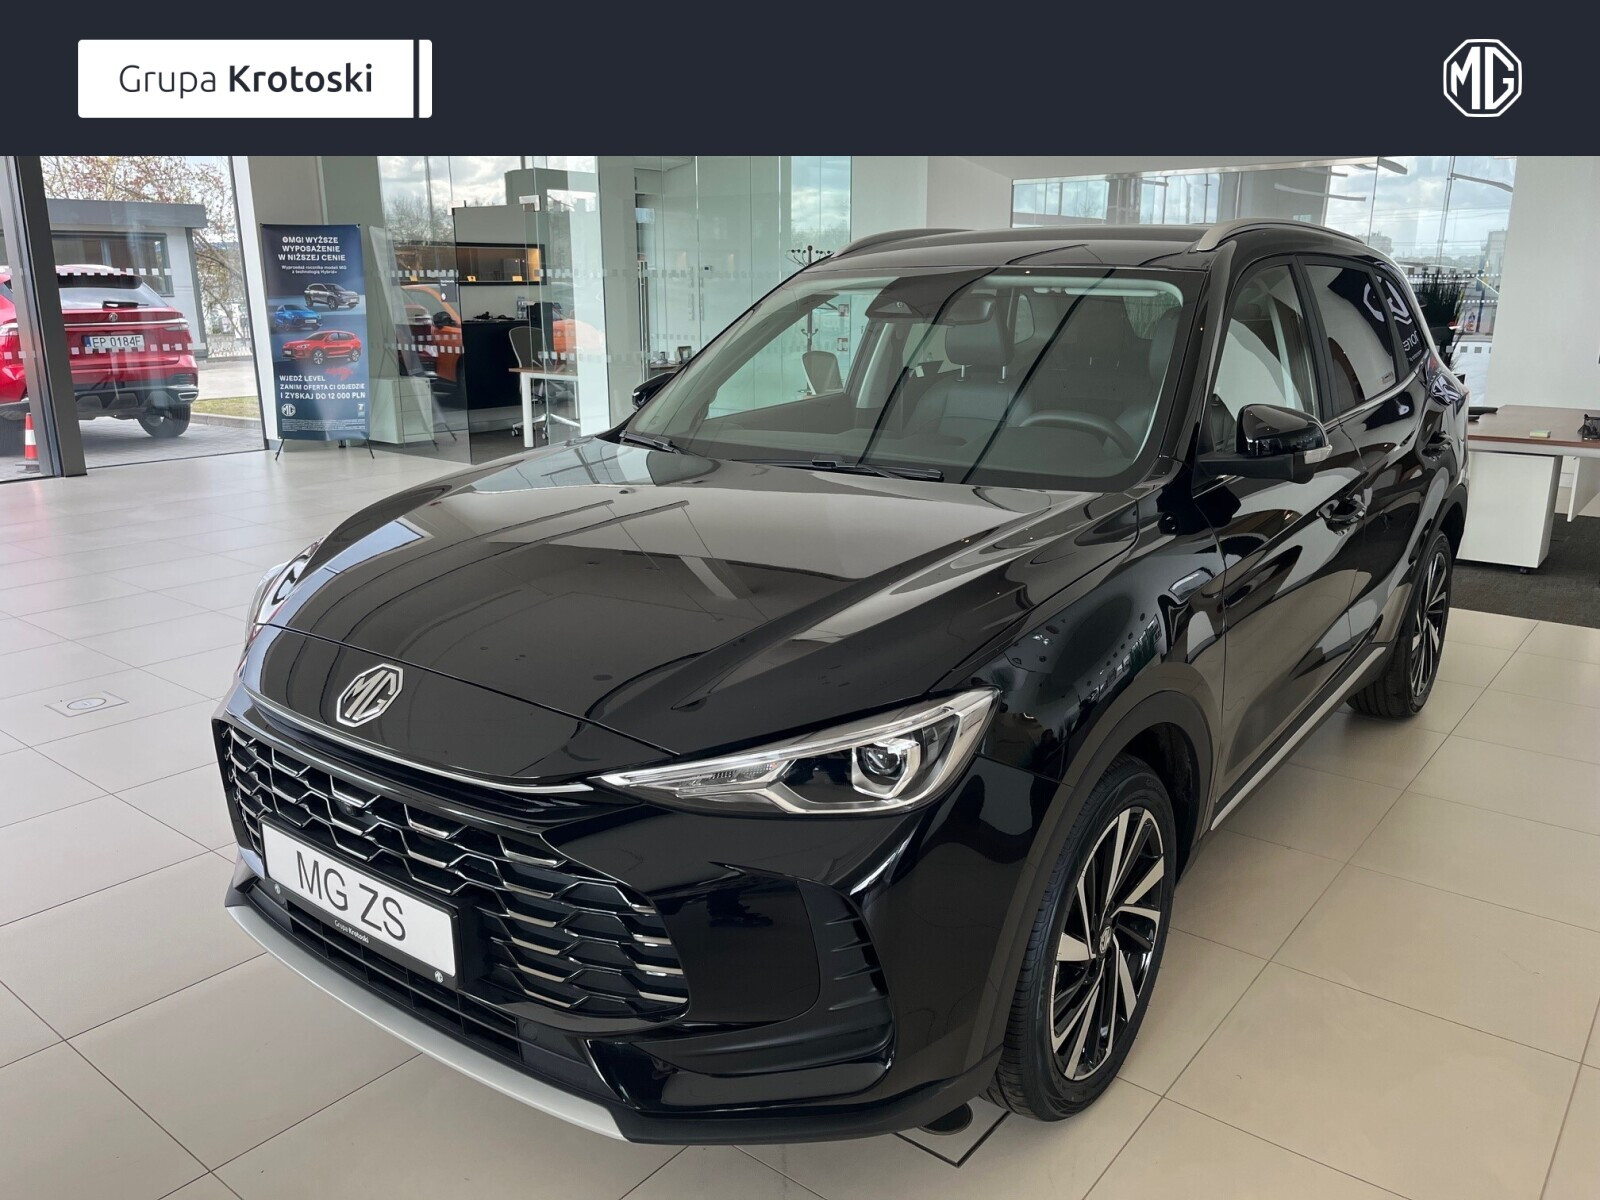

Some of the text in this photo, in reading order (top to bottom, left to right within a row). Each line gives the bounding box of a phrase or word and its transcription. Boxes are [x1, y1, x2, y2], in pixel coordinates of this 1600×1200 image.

[305, 235, 339, 244] WYŻSZE
[281, 244, 341, 252] WYPOSAŻENIE
[278, 252, 346, 261] W NIŻSZEJ CENIE
[92, 337, 106, 348] EP
[284, 392, 314, 400] ZYSKAJ
[352, 391, 366, 399] PLN
[281, 403, 296, 417] MG
[341, 667, 399, 723] MG
[297, 850, 406, 941] MG ZS
